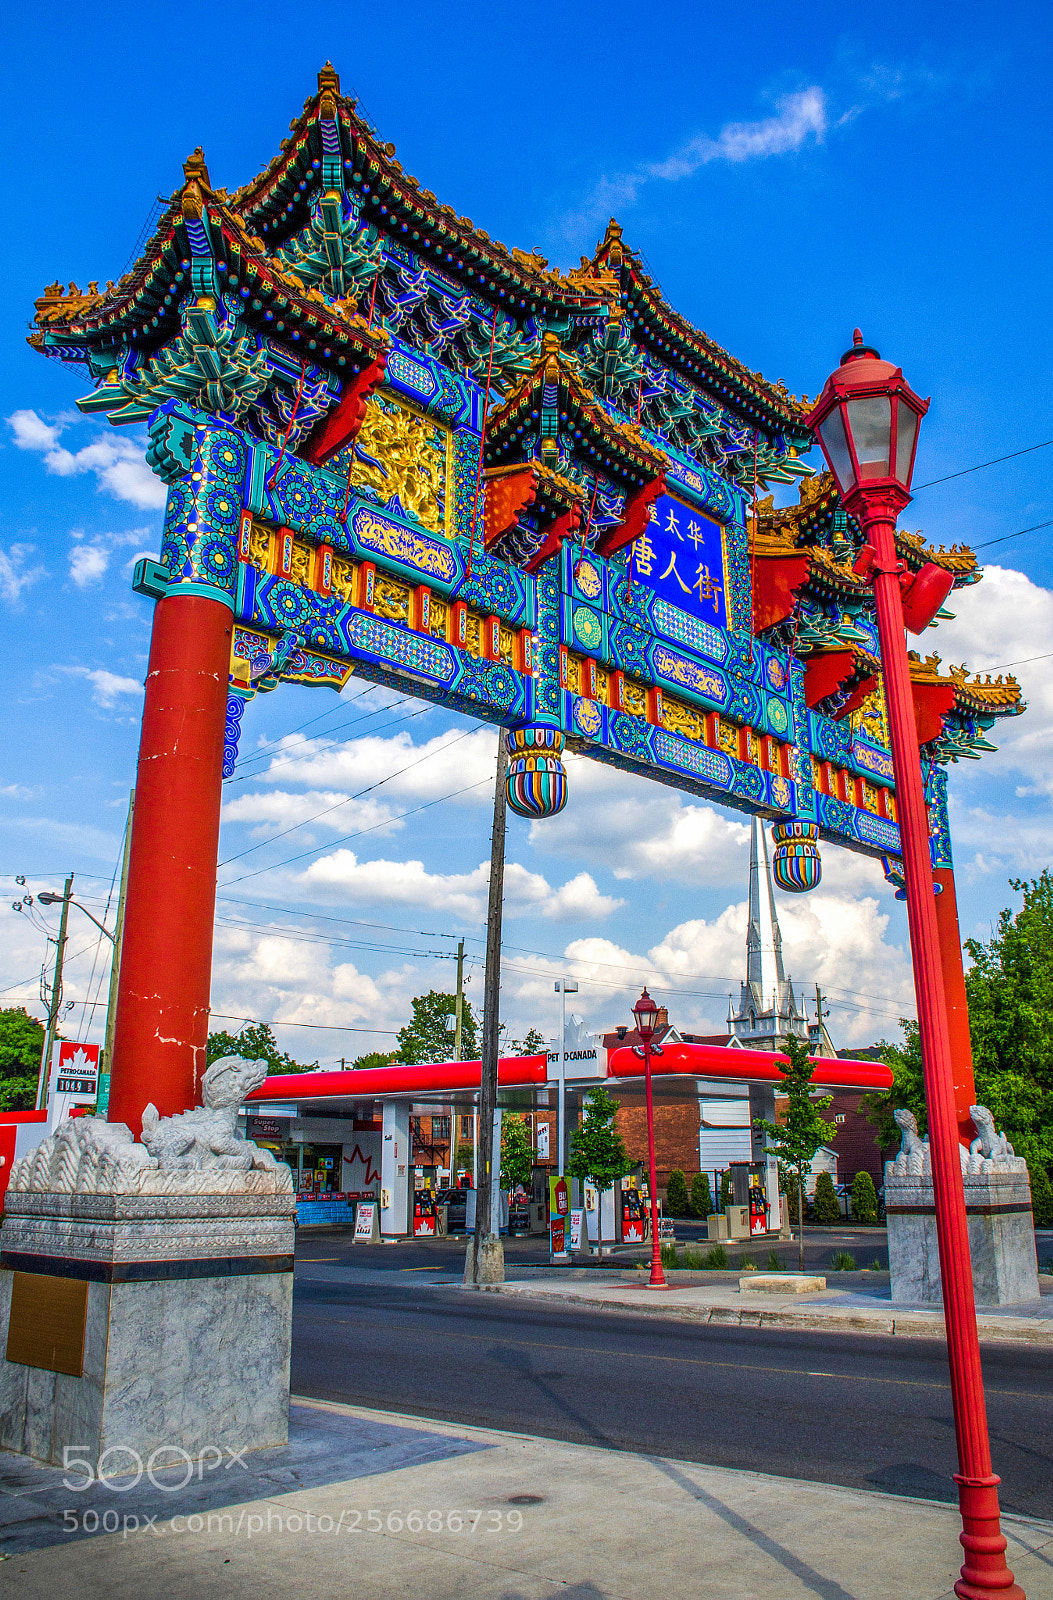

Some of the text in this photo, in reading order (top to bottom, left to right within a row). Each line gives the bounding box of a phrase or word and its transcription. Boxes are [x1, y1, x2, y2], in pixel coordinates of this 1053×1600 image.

[626, 533, 722, 613] 唐人街
[547, 1049, 598, 1063] PETO-CANADA
[253, 1118, 276, 1126] Super
[262, 1125, 280, 1133] Stop
